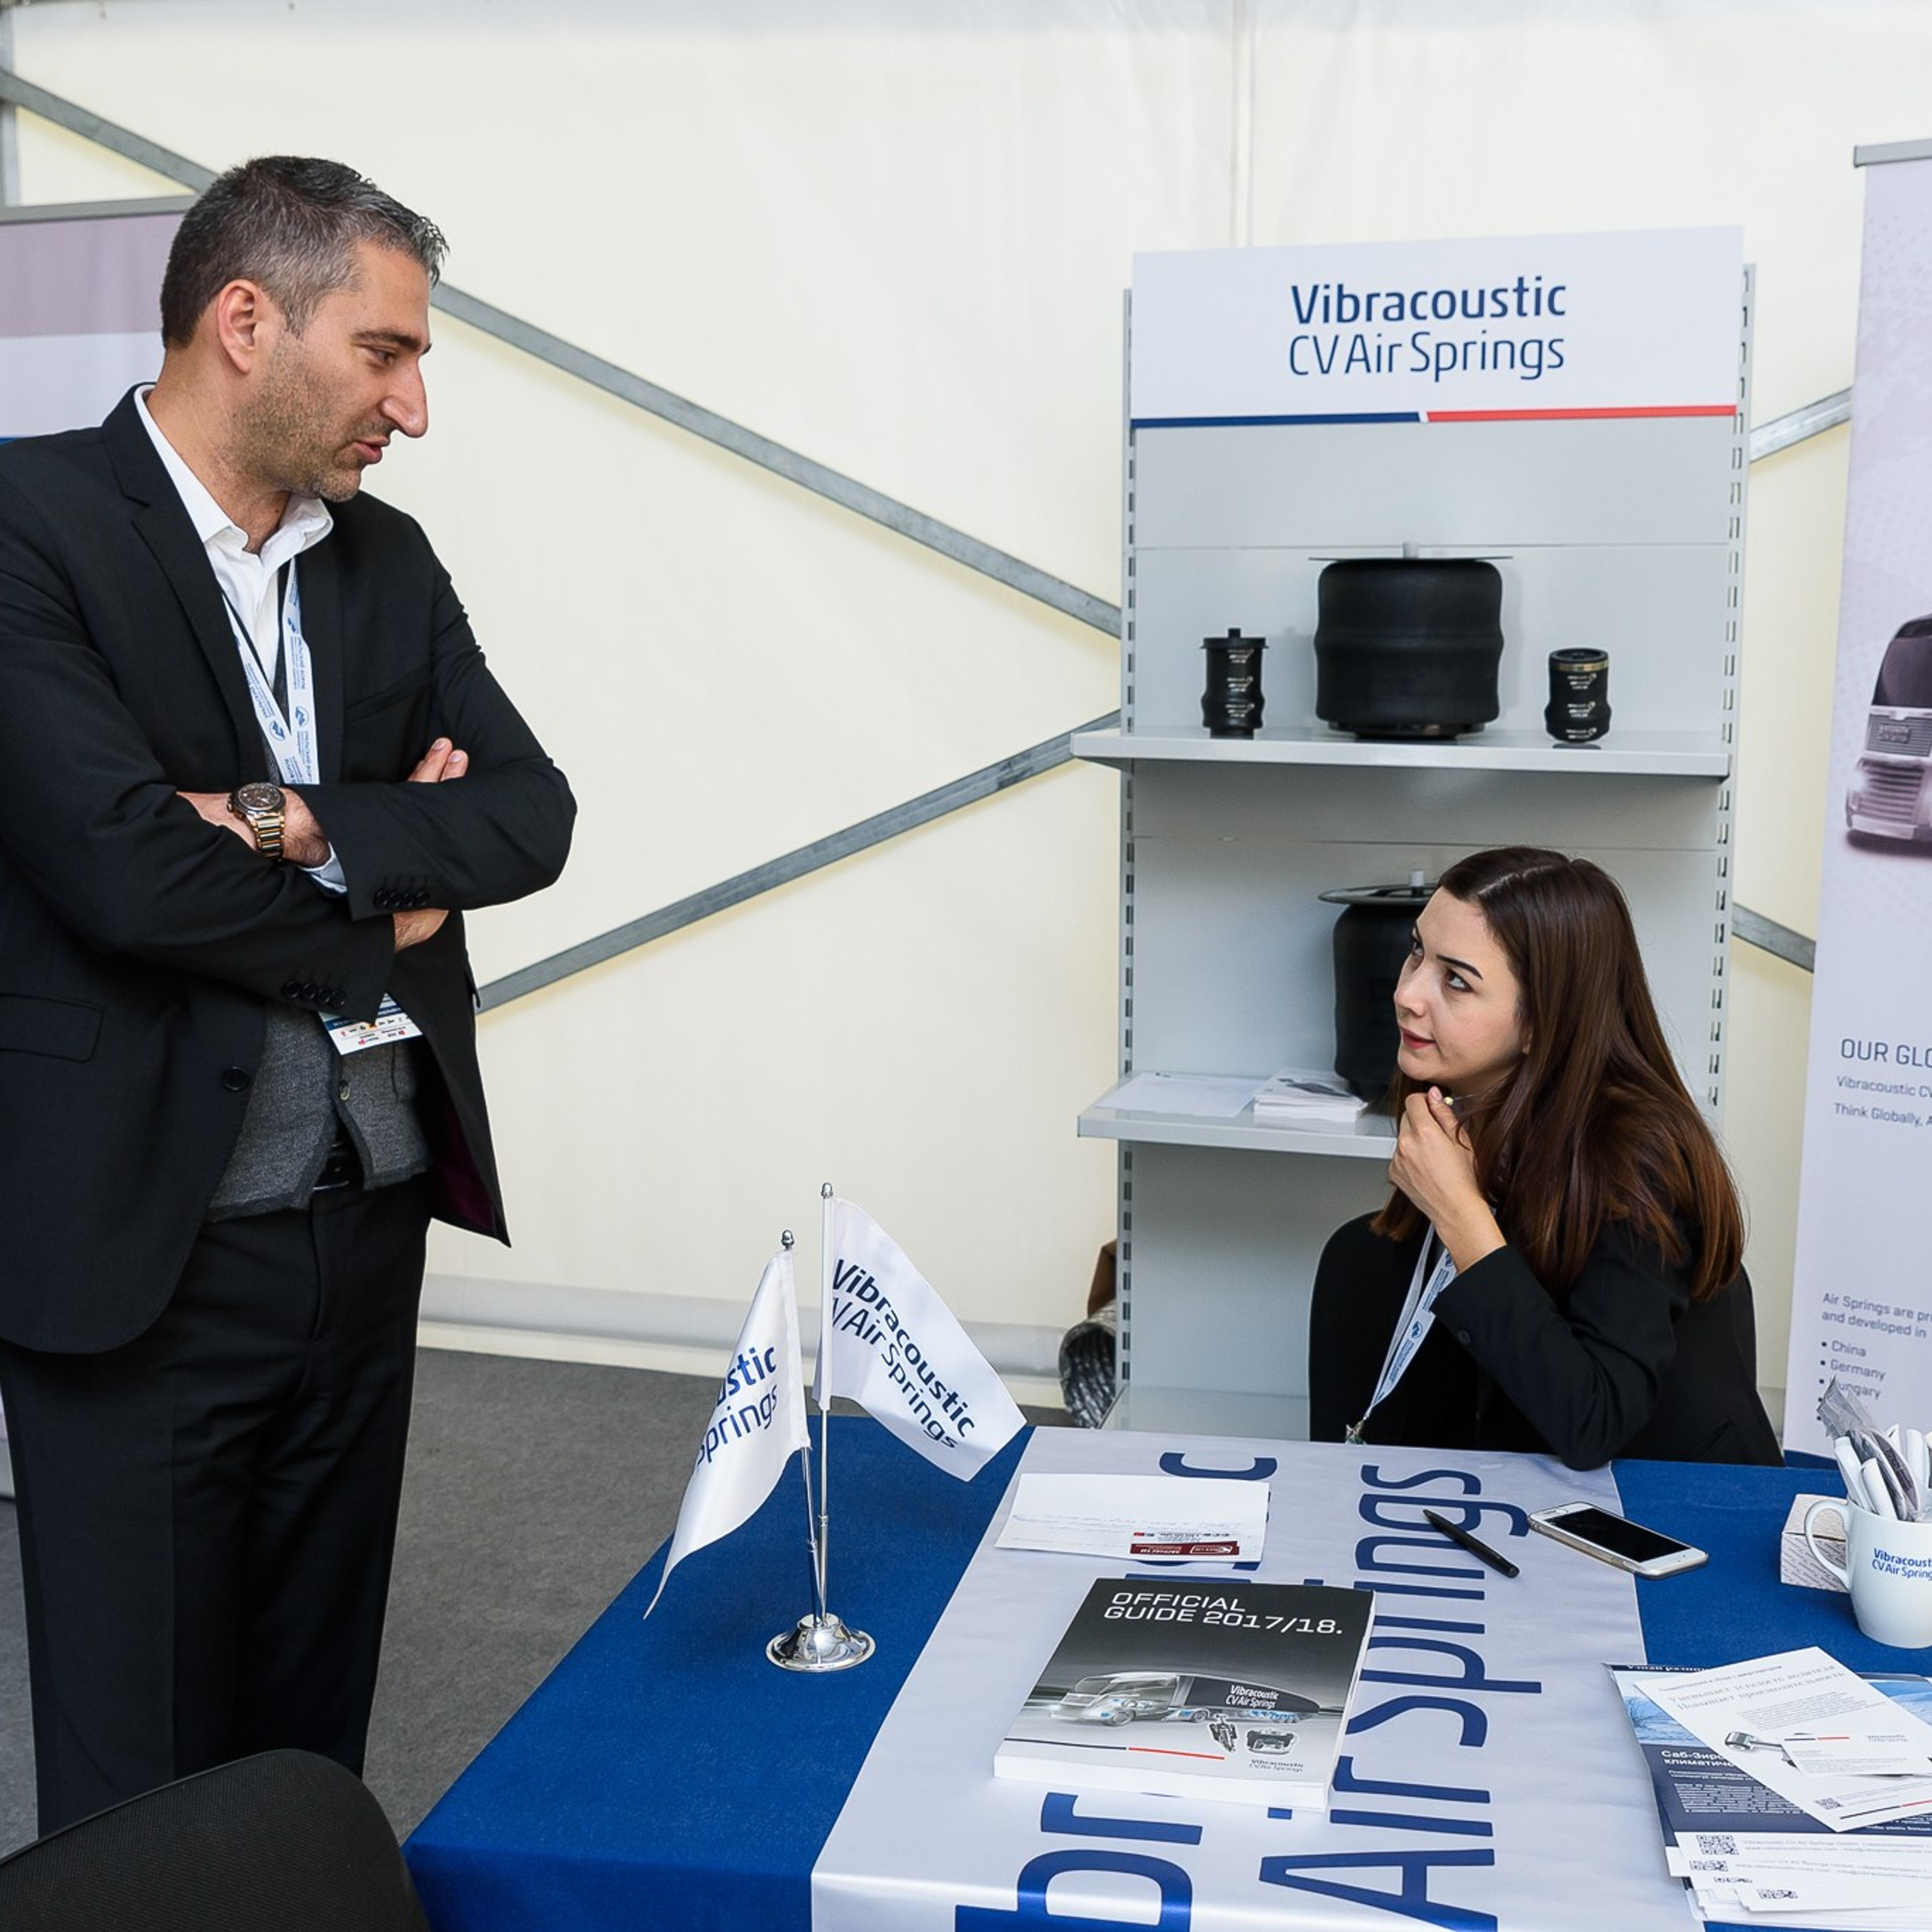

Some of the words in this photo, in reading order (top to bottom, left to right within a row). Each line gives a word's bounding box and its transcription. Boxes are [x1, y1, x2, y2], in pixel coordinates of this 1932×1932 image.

[1291, 275, 1566, 325] Vibracoustic
[1410, 330, 1565, 383] Springs
[1841, 1038, 1889, 1063] OUR
[1836, 1075, 1916, 1096] Vibracoustic
[1835, 1102, 1869, 1118] Think
[1823, 1293, 1839, 1305] Air
[1842, 1296, 1890, 1316] Springs
[1894, 1306, 1915, 1318] are
[1822, 1311, 1845, 1323] and
[1848, 1315, 1912, 1336] developed
[1915, 1326, 1927, 1338] in
[832, 1258, 977, 1438] Vibracoustic
[1832, 1340, 1866, 1357] China
[1830, 1359, 1886, 1383] Germany
[881, 1343, 958, 1450] Springs
[1832, 1380, 1881, 1400] ungary
[1873, 1547, 1932, 1567] Vibracoust
[1111, 1592, 1246, 1613] OFFICIAL
[1103, 1606, 1196, 1623] GUIDE
[1201, 1610, 1344, 1635] 2017/18.
[1230, 1684, 1279, 1700] Vibracoustic
[1250, 1697, 1276, 1709] Springs
